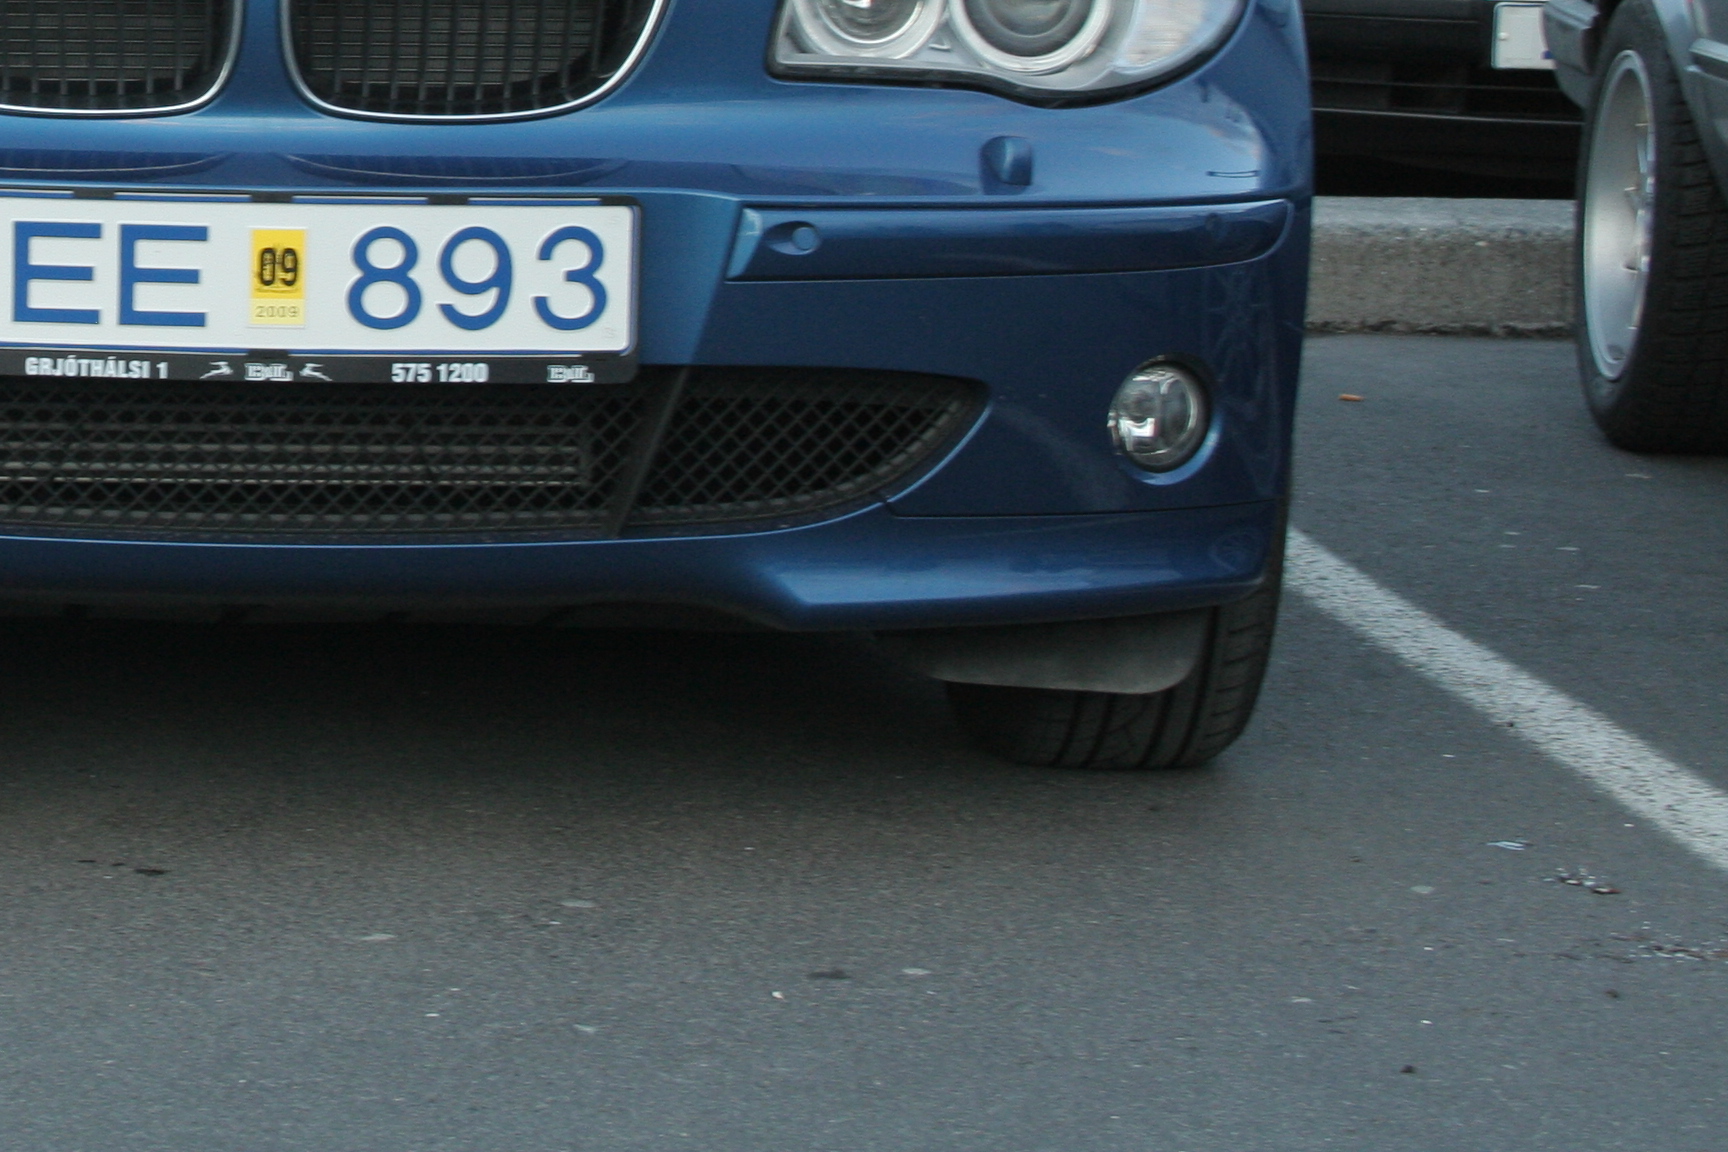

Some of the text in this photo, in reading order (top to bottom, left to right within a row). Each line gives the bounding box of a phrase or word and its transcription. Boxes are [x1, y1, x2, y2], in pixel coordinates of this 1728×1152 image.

[10, 221, 609, 332] EE 893
[260, 247, 298, 286] 09
[255, 305, 300, 318] 2009
[24, 355, 151, 379] GRJÓTHÁLSI
[156, 361, 169, 379] 1
[391, 362, 432, 383] 575
[436, 362, 489, 384] 1200
